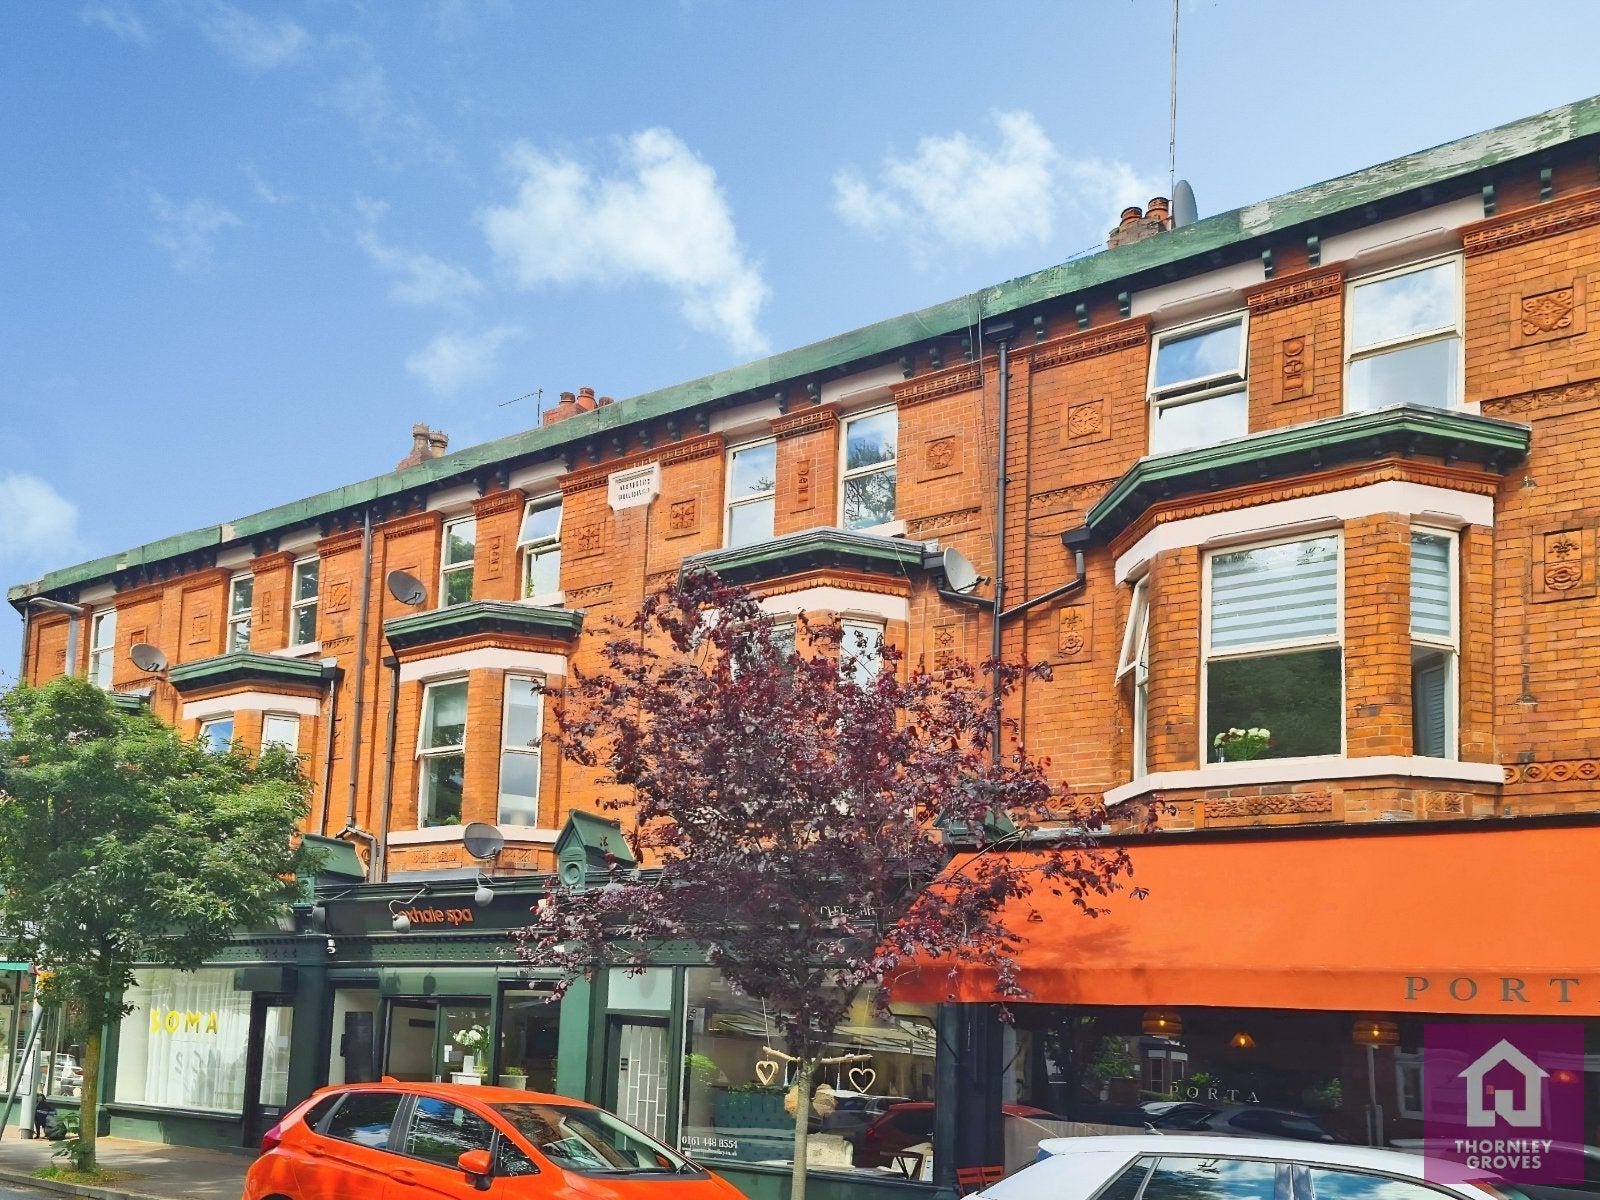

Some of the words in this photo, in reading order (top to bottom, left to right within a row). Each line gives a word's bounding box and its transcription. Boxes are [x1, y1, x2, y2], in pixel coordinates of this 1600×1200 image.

[446, 909, 474, 925] spa
[1404, 976, 1600, 1003] PORT
[150, 1009, 218, 1034] SOMA
[1169, 1081, 1260, 1103] PORTA
[682, 1136, 700, 1146] 0161
[702, 1137, 717, 1147] 448
